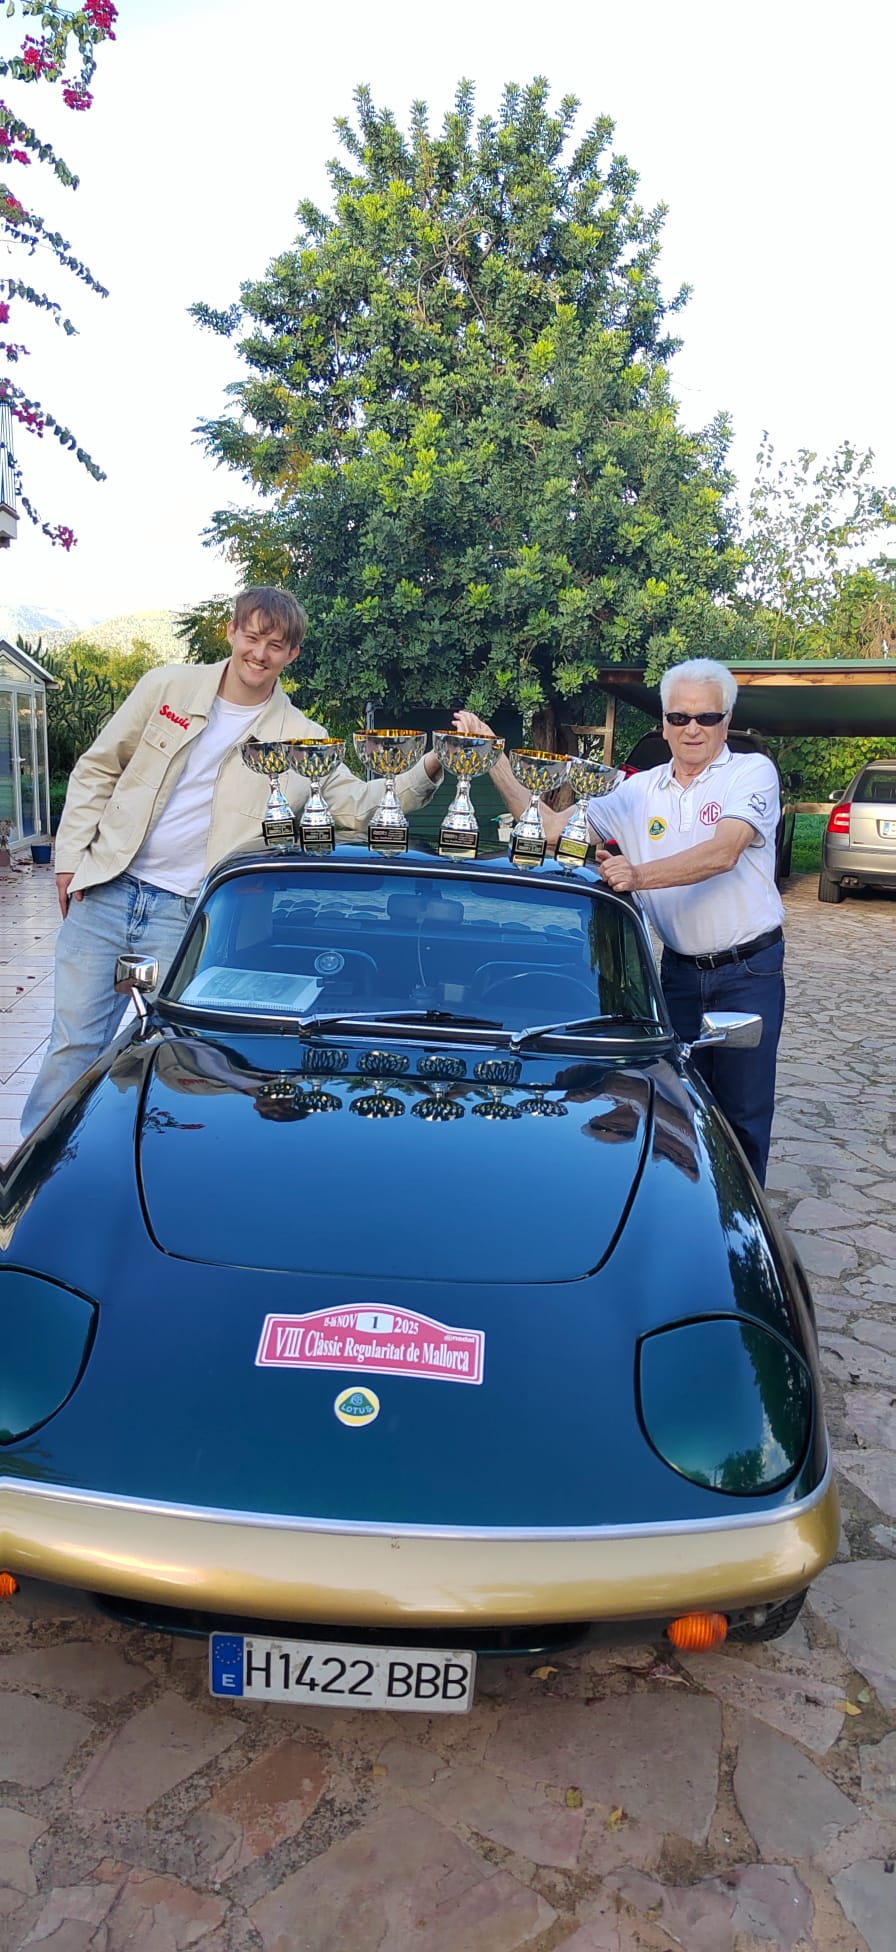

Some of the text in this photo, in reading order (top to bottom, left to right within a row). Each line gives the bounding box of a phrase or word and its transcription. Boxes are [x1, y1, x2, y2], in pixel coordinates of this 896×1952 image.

[702, 804, 719, 822] MG
[336, 1313, 358, 1328] NOV
[369, 1315, 379, 1329] 1
[393, 1317, 420, 1335] 2025
[276, 1327, 469, 1372] VIII Clàssic Regularitat de Mallorca
[340, 1403, 373, 1415] LOTUS
[222, 1674, 236, 1687] E
[246, 1650, 468, 1699] H1422 BBB
